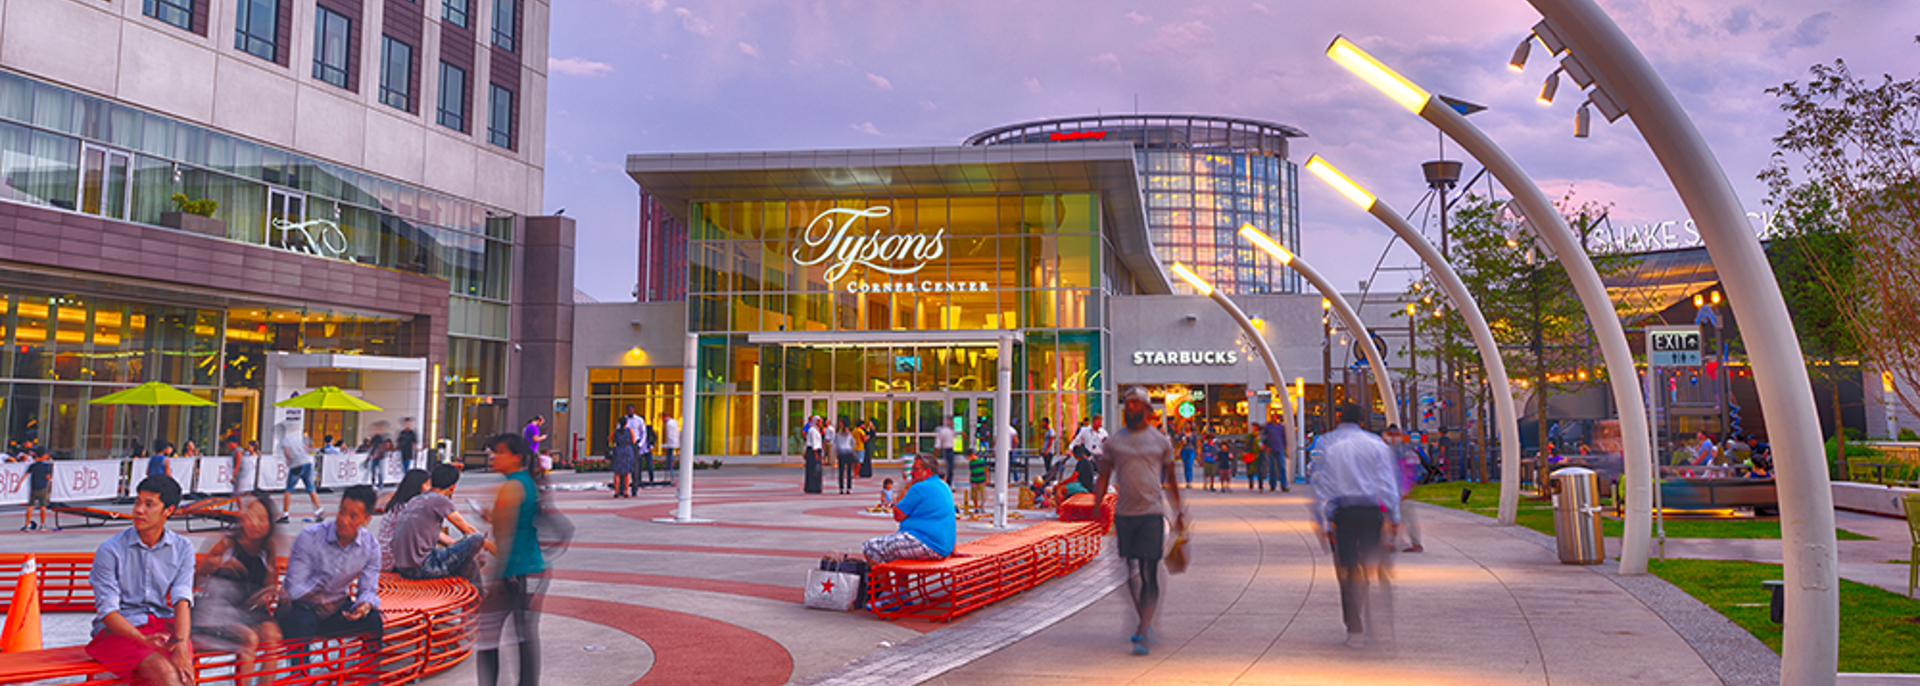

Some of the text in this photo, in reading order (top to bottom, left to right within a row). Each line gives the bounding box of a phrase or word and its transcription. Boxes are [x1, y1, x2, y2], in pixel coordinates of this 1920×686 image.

[792, 206, 945, 282] Tysons
[1592, 209, 1784, 252] SHAKE SCK
[1655, 334, 1687, 349] EXIT
[1133, 350, 1238, 365] STARBUCKS
